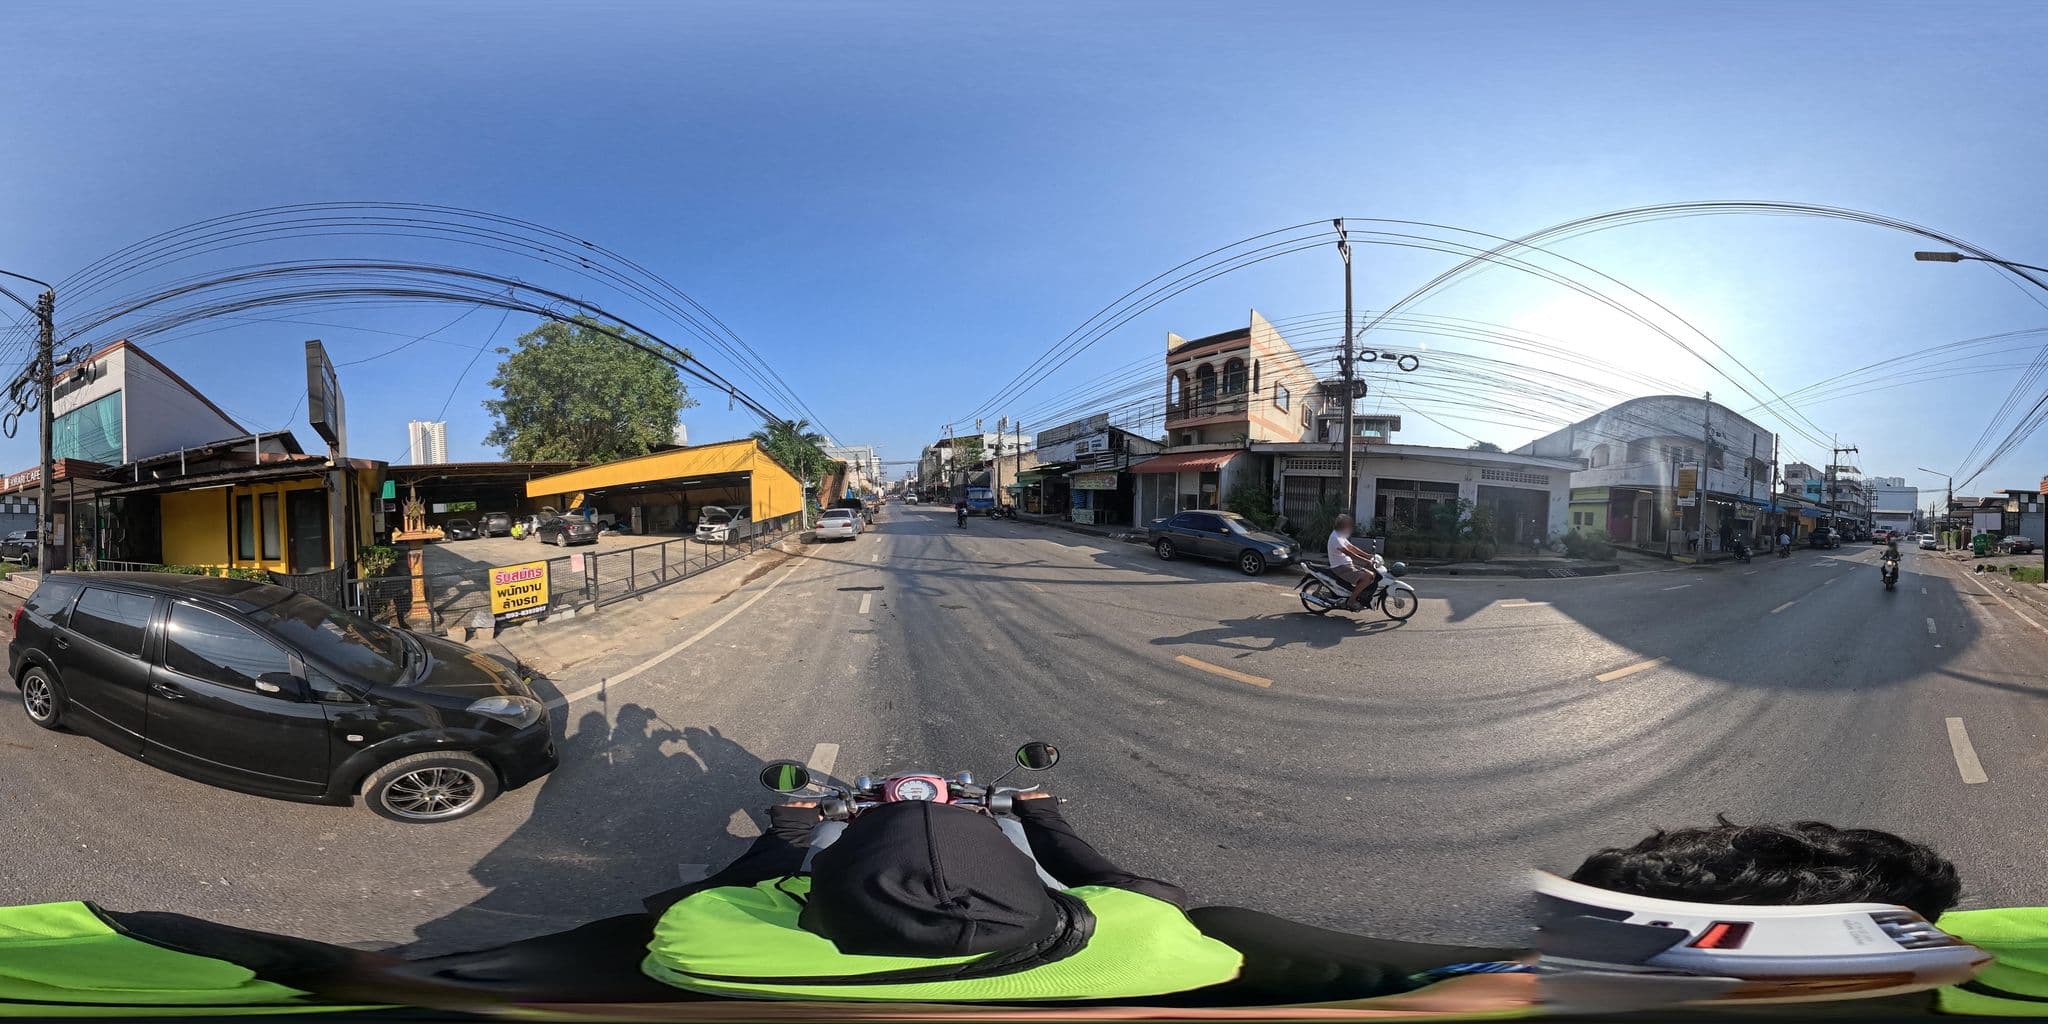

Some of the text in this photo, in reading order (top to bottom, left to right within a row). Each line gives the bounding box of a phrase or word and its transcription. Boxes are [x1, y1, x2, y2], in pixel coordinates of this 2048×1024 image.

[495, 567, 543, 585] รับสมัคร
[497, 582, 542, 598] พนักงาน
[502, 595, 538, 609] ล้างรถ
